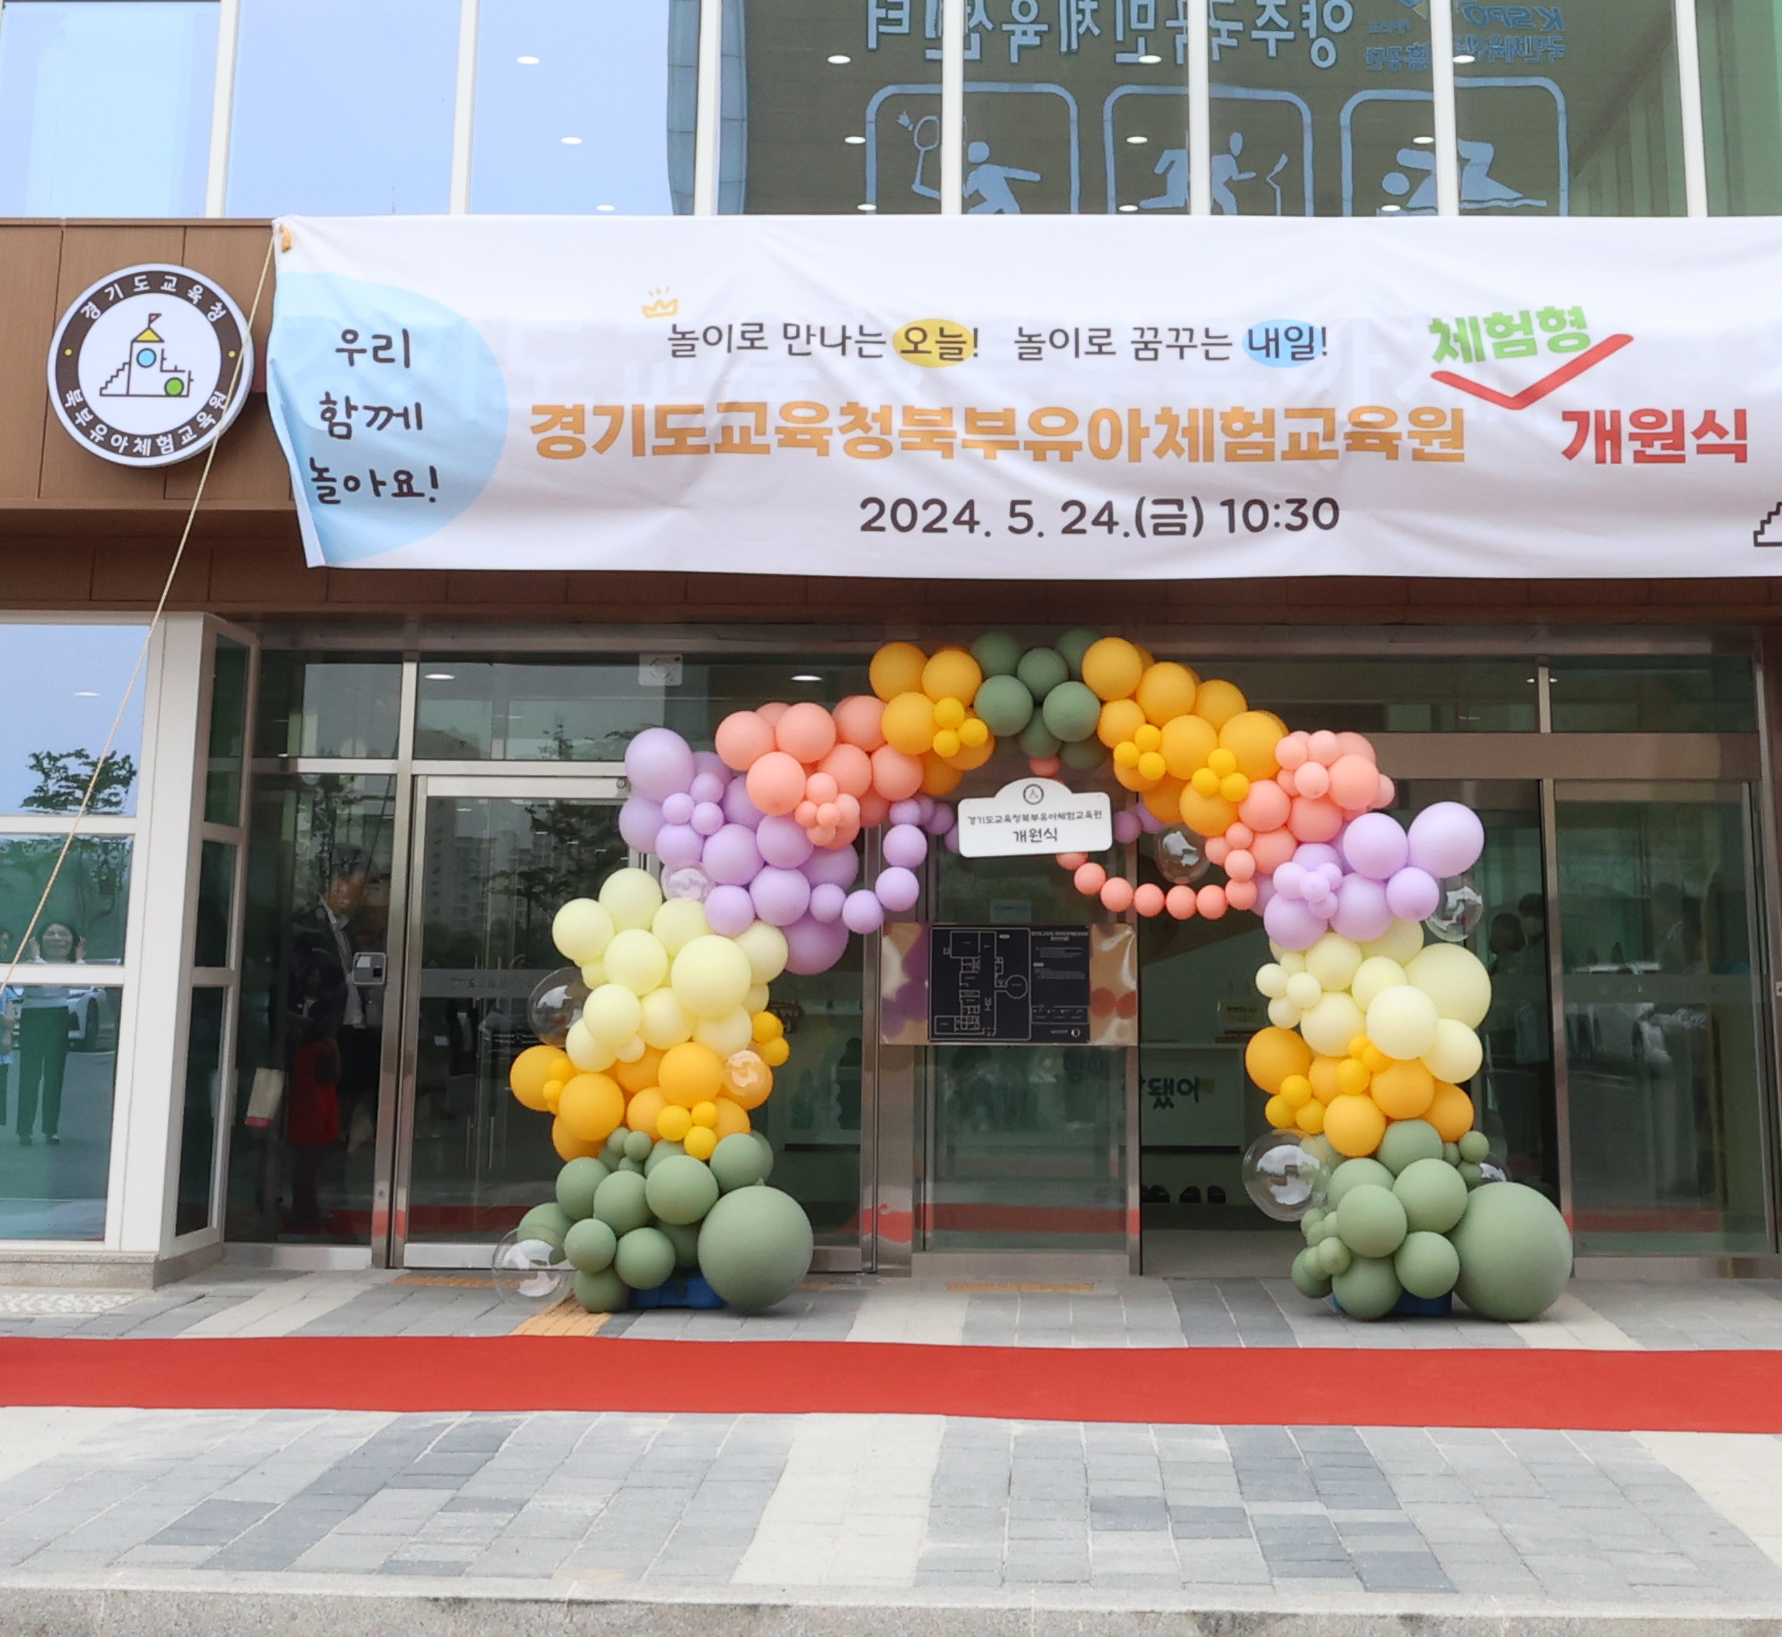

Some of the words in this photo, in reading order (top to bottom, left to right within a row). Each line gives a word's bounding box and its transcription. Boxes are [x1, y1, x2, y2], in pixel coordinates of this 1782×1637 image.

[79, 274, 227, 322] 경기도교육청
[334, 328, 411, 369] 우리
[667, 322, 768, 358] 놀이로
[783, 323, 887, 359] 만나는
[901, 327, 979, 361] 오늘!
[1014, 326, 1116, 361] 놀이로
[1130, 327, 1233, 362] 꿈꾸는
[1247, 325, 1327, 362] 내일!
[1428, 305, 1591, 366] 체험형
[64, 388, 228, 457] 북부유아체험교육원
[319, 392, 423, 440] 함께
[529, 400, 1466, 465] 경기도교육청북부유아체험교육원
[1560, 407, 1749, 465] 개원식
[309, 456, 439, 506] 놀아요!
[859, 496, 991, 538] 2024.
[1007, 499, 1045, 538] 5.
[1060, 495, 1204, 539] 24.(금)
[1219, 496, 1340, 534] 10:30
[966, 809, 1103, 827] 경기도교육청북부유아체험교육원
[1012, 827, 1059, 844] 개원식
